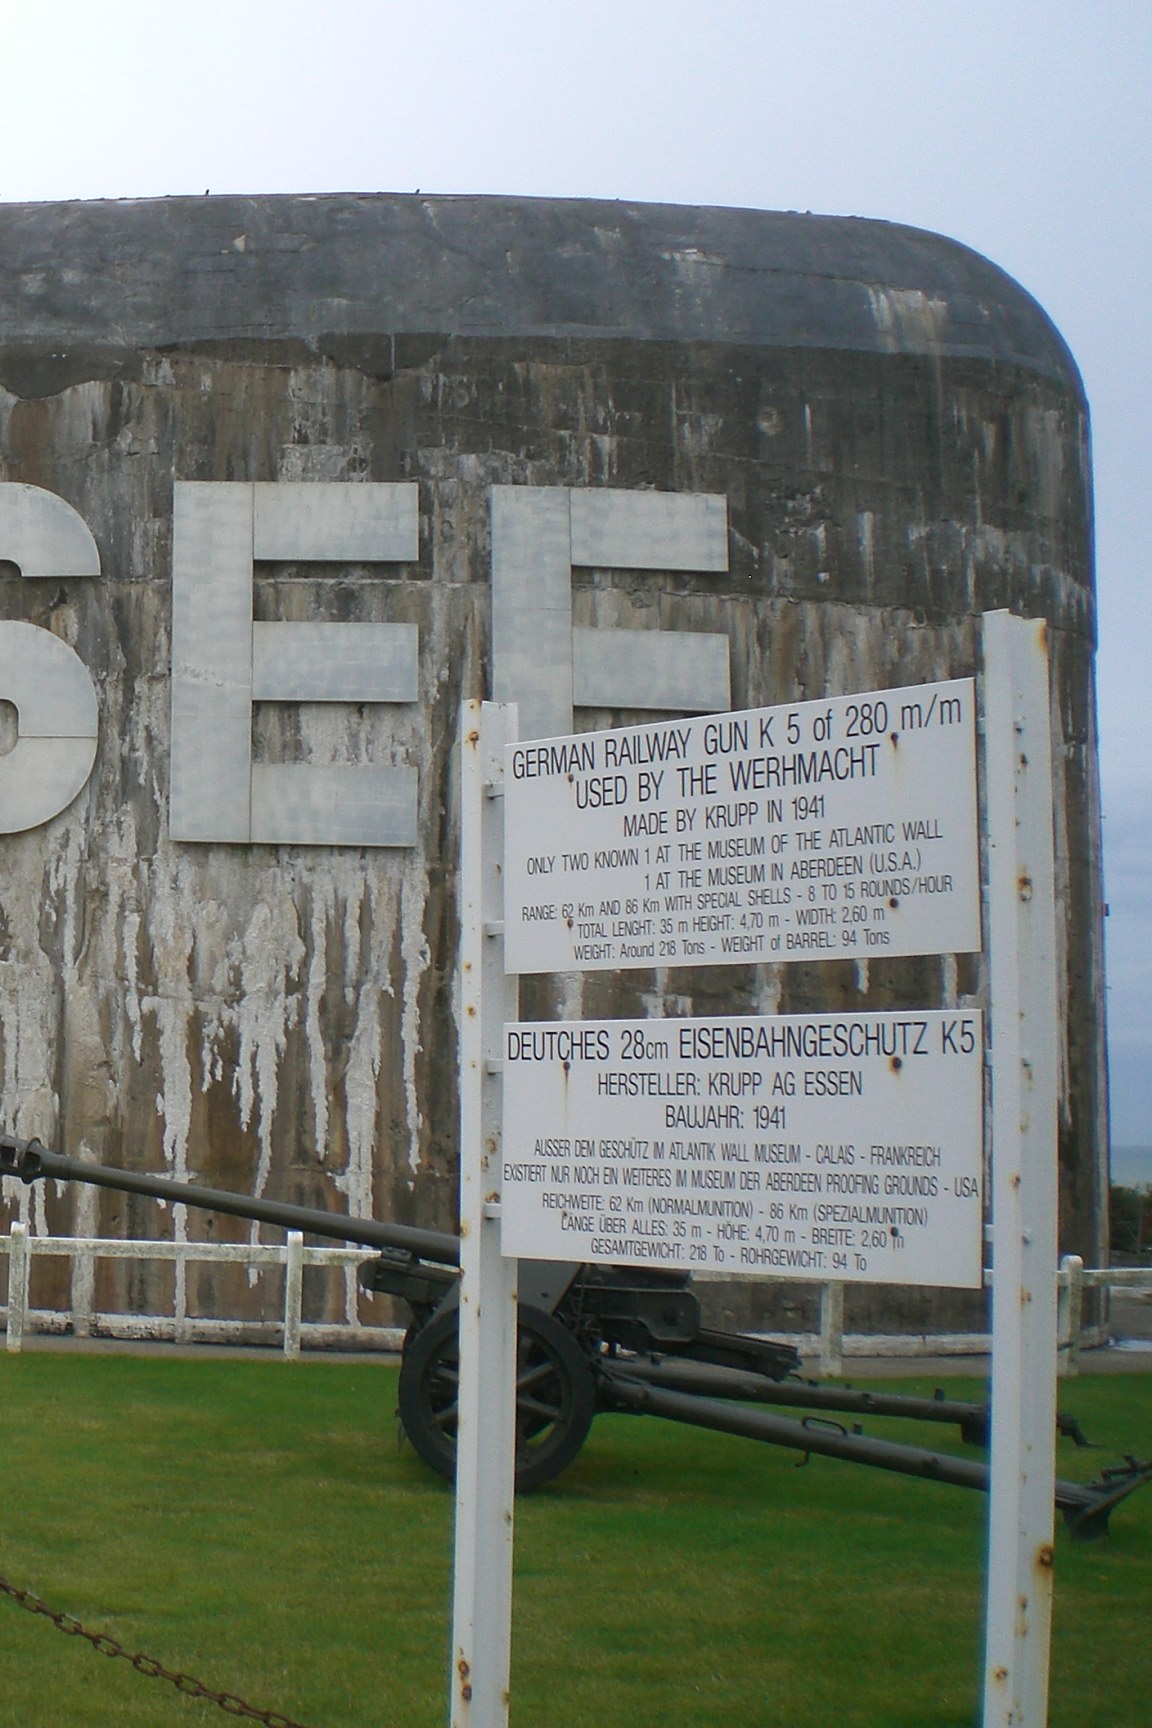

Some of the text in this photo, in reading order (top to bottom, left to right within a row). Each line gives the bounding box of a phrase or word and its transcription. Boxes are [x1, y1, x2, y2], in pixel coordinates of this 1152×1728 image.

[512, 694, 962, 780] GERMAN RAILWAY GUN K 5 of 280 m/m
[576, 744, 880, 809] USED BY THE WERHMACHT
[624, 794, 825, 837] MADE BY KRUPP IN 1941
[527, 820, 943, 875] ONLY TWO KNOWN 1 AT THE MUSEUM OF THE ATLANTIC WALL
[644, 848, 922, 890] 1 AT THE MUSEUM IN ABERDEEN (U.S.A.)
[522, 906, 557, 921] RANGE:
[562, 904, 574, 918] 62
[578, 902, 594, 918] Km
[599, 900, 620, 916] AND
[626, 898, 638, 914] 86
[643, 898, 660, 913] Km
[665, 895, 692, 912] WITH
[697, 892, 742, 910] SPECIAL
[748, 886, 790, 906] SHELLS
[808, 886, 815, 902] 8
[822, 884, 837, 900] TO
[844, 883, 855, 900] 15
[860, 874, 952, 898] ROUNDS/HOUR
[577, 922, 607, 939] TOTAL
[612, 920, 655, 937] LENGHT:
[660, 920, 672, 934] 35
[678, 921, 688, 932] m
[693, 914, 734, 932] HEIGHT:
[740, 912, 763, 930] 4,70
[768, 915, 780, 928] m
[796, 908, 836, 926] WIDTH:
[842, 906, 867, 924] 2,60
[873, 906, 884, 920] m
[574, 944, 615, 960] WEIGHT:
[620, 942, 654, 958] Around
[659, 940, 676, 956] 218
[682, 939, 704, 954] Tons
[722, 934, 764, 953] WEIGHT
[771, 934, 780, 950] of
[786, 931, 836, 950] BARREL:
[842, 930, 856, 946] 94
[864, 928, 890, 946] Tons
[507, 1020, 975, 1061] DEUTCHES 28cm EISENBAHNGESCHUTZ K5
[598, 1071, 862, 1096] HERSTELLER: KRUPP AG ESSEN
[666, 1105, 786, 1129] BAUJAHR: 1941
[534, 1139, 570, 1157] AUSSER
[575, 1140, 595, 1158] DEM
[599, 1137, 648, 1159] GESCHÜTZ
[653, 1142, 664, 1160] IM
[670, 1142, 716, 1161] ATLANTIK
[721, 1144, 748, 1162] WALL
[754, 1144, 801, 1164] MUSEUM
[816, 1145, 854, 1165] CALAIS
[870, 1146, 941, 1167] FRANKREICH
[504, 1163, 547, 1183] EXISTIERT
[551, 1165, 570, 1183] NUR
[574, 1166, 598, 1184] NOCH
[603, 1167, 618, 1185] EIN
[623, 1168, 671, 1187] WEITERES
[676, 1170, 687, 1187] IM
[691, 1170, 735, 1190] MUSEUM
[740, 1172, 760, 1191] DER
[766, 1173, 821, 1193] ABERDEEN
[827, 1174, 879, 1194] PROOFING
[884, 1176, 938, 1196] GROUNDS
[954, 1177, 978, 1198] USA
[542, 1193, 604, 1211] REICHWEITE:
[609, 1196, 622, 1212] 62
[627, 1199, 643, 1213] Km
[649, 1199, 753, 1219] (NORMALMUNITION)
[770, 1203, 783, 1219] 86
[789, 1205, 808, 1221] Km
[814, 1205, 928, 1227] (SPEZIALMUNITION)
[599, 1213, 627, 1234] ÜBER
[632, 1220, 668, 1236] ALLES:
[673, 1222, 686, 1237] 35
[691, 1226, 702, 1238] m
[717, 1220, 749, 1241] HÖHE:
[755, 1225, 779, 1243] 4,70
[784, 1230, 795, 1242] m
[812, 1229, 855, 1246] BREITE:
[861, 1232, 887, 1248] 2,60
[591, 1239, 685, 1260] GESAMTGEWICHT:
[690, 1244, 706, 1261] 218
[713, 1245, 724, 1261] To
[741, 1248, 827, 1269] ROHRGEWICHT:
[833, 1253, 847, 1269] 94
[854, 1254, 867, 1271] To
